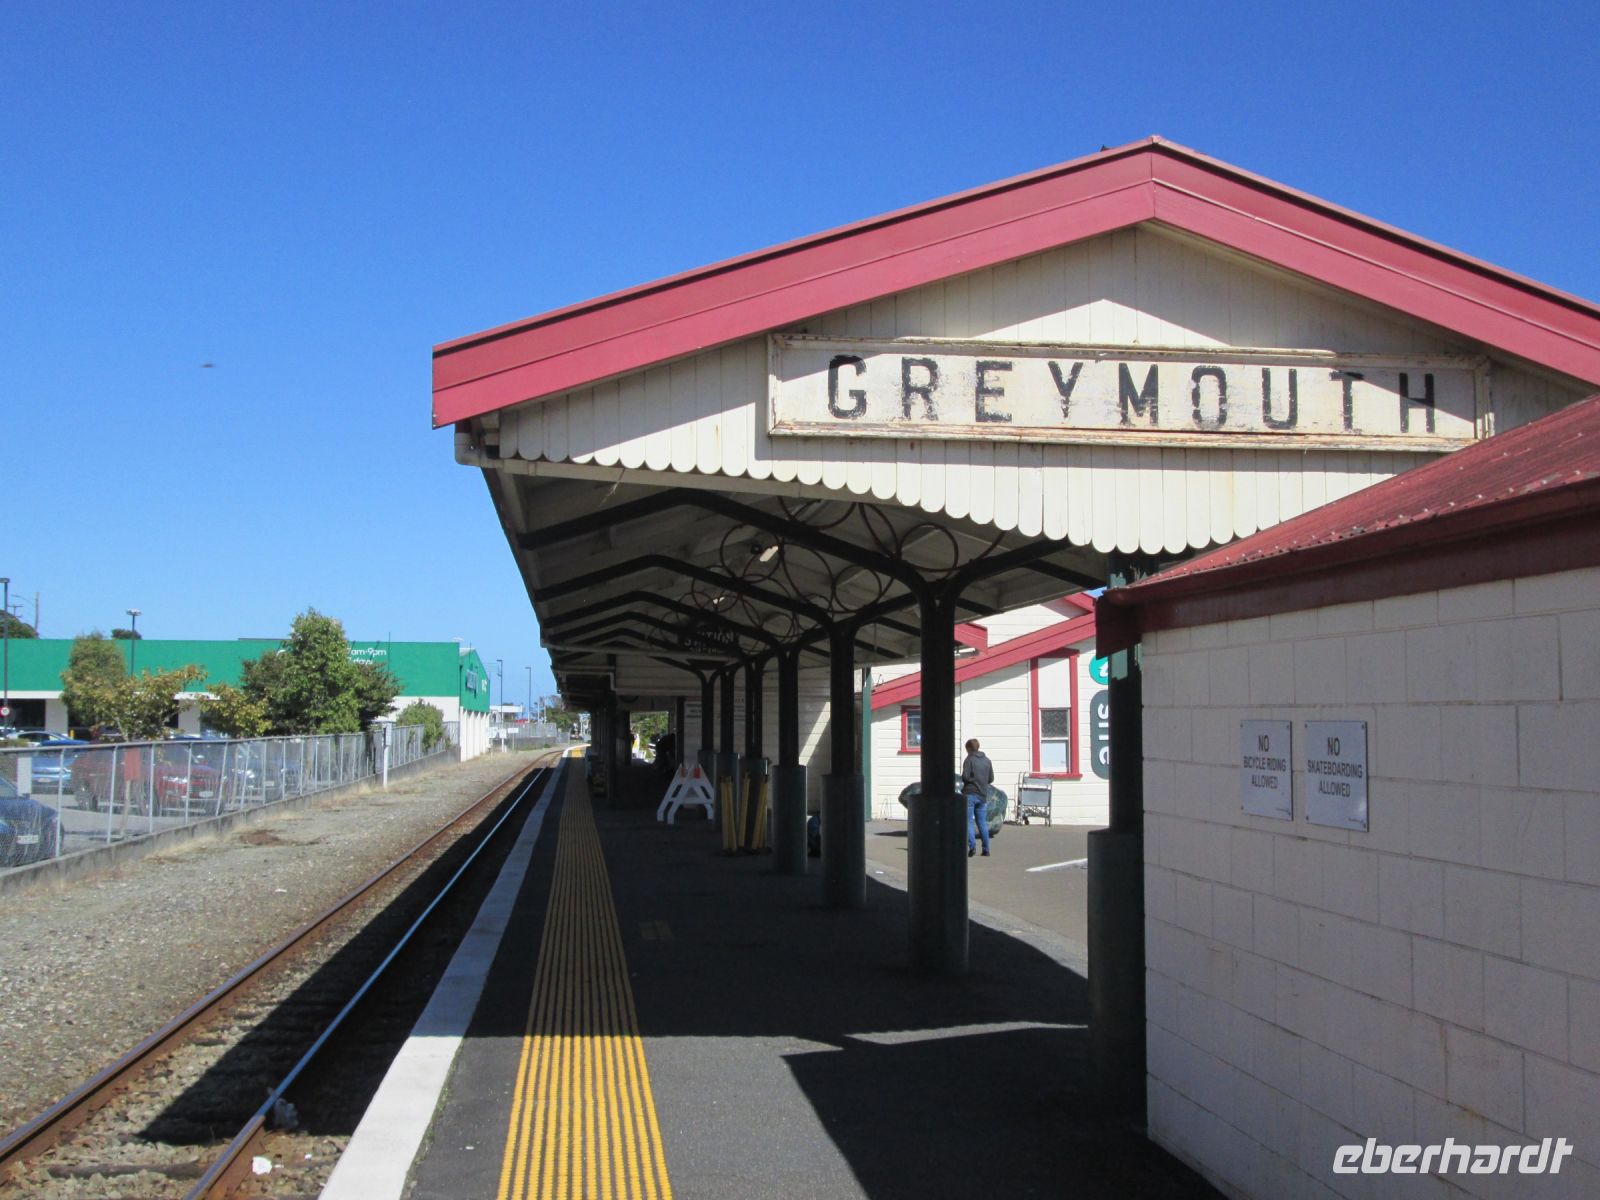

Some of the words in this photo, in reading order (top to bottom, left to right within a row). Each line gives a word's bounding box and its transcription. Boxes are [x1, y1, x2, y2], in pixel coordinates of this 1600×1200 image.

[827, 354, 1436, 433] GREYMOUTH
[1258, 735, 1270, 752] NO
[1327, 737, 1341, 756] NO
[1243, 756, 1266, 770] BICYCLE
[1266, 758, 1287, 772] RIDING
[1307, 760, 1363, 779] SKATEBOARDING
[1251, 774, 1278, 789] ALLOWED
[1318, 780, 1351, 797] ALLOWED
